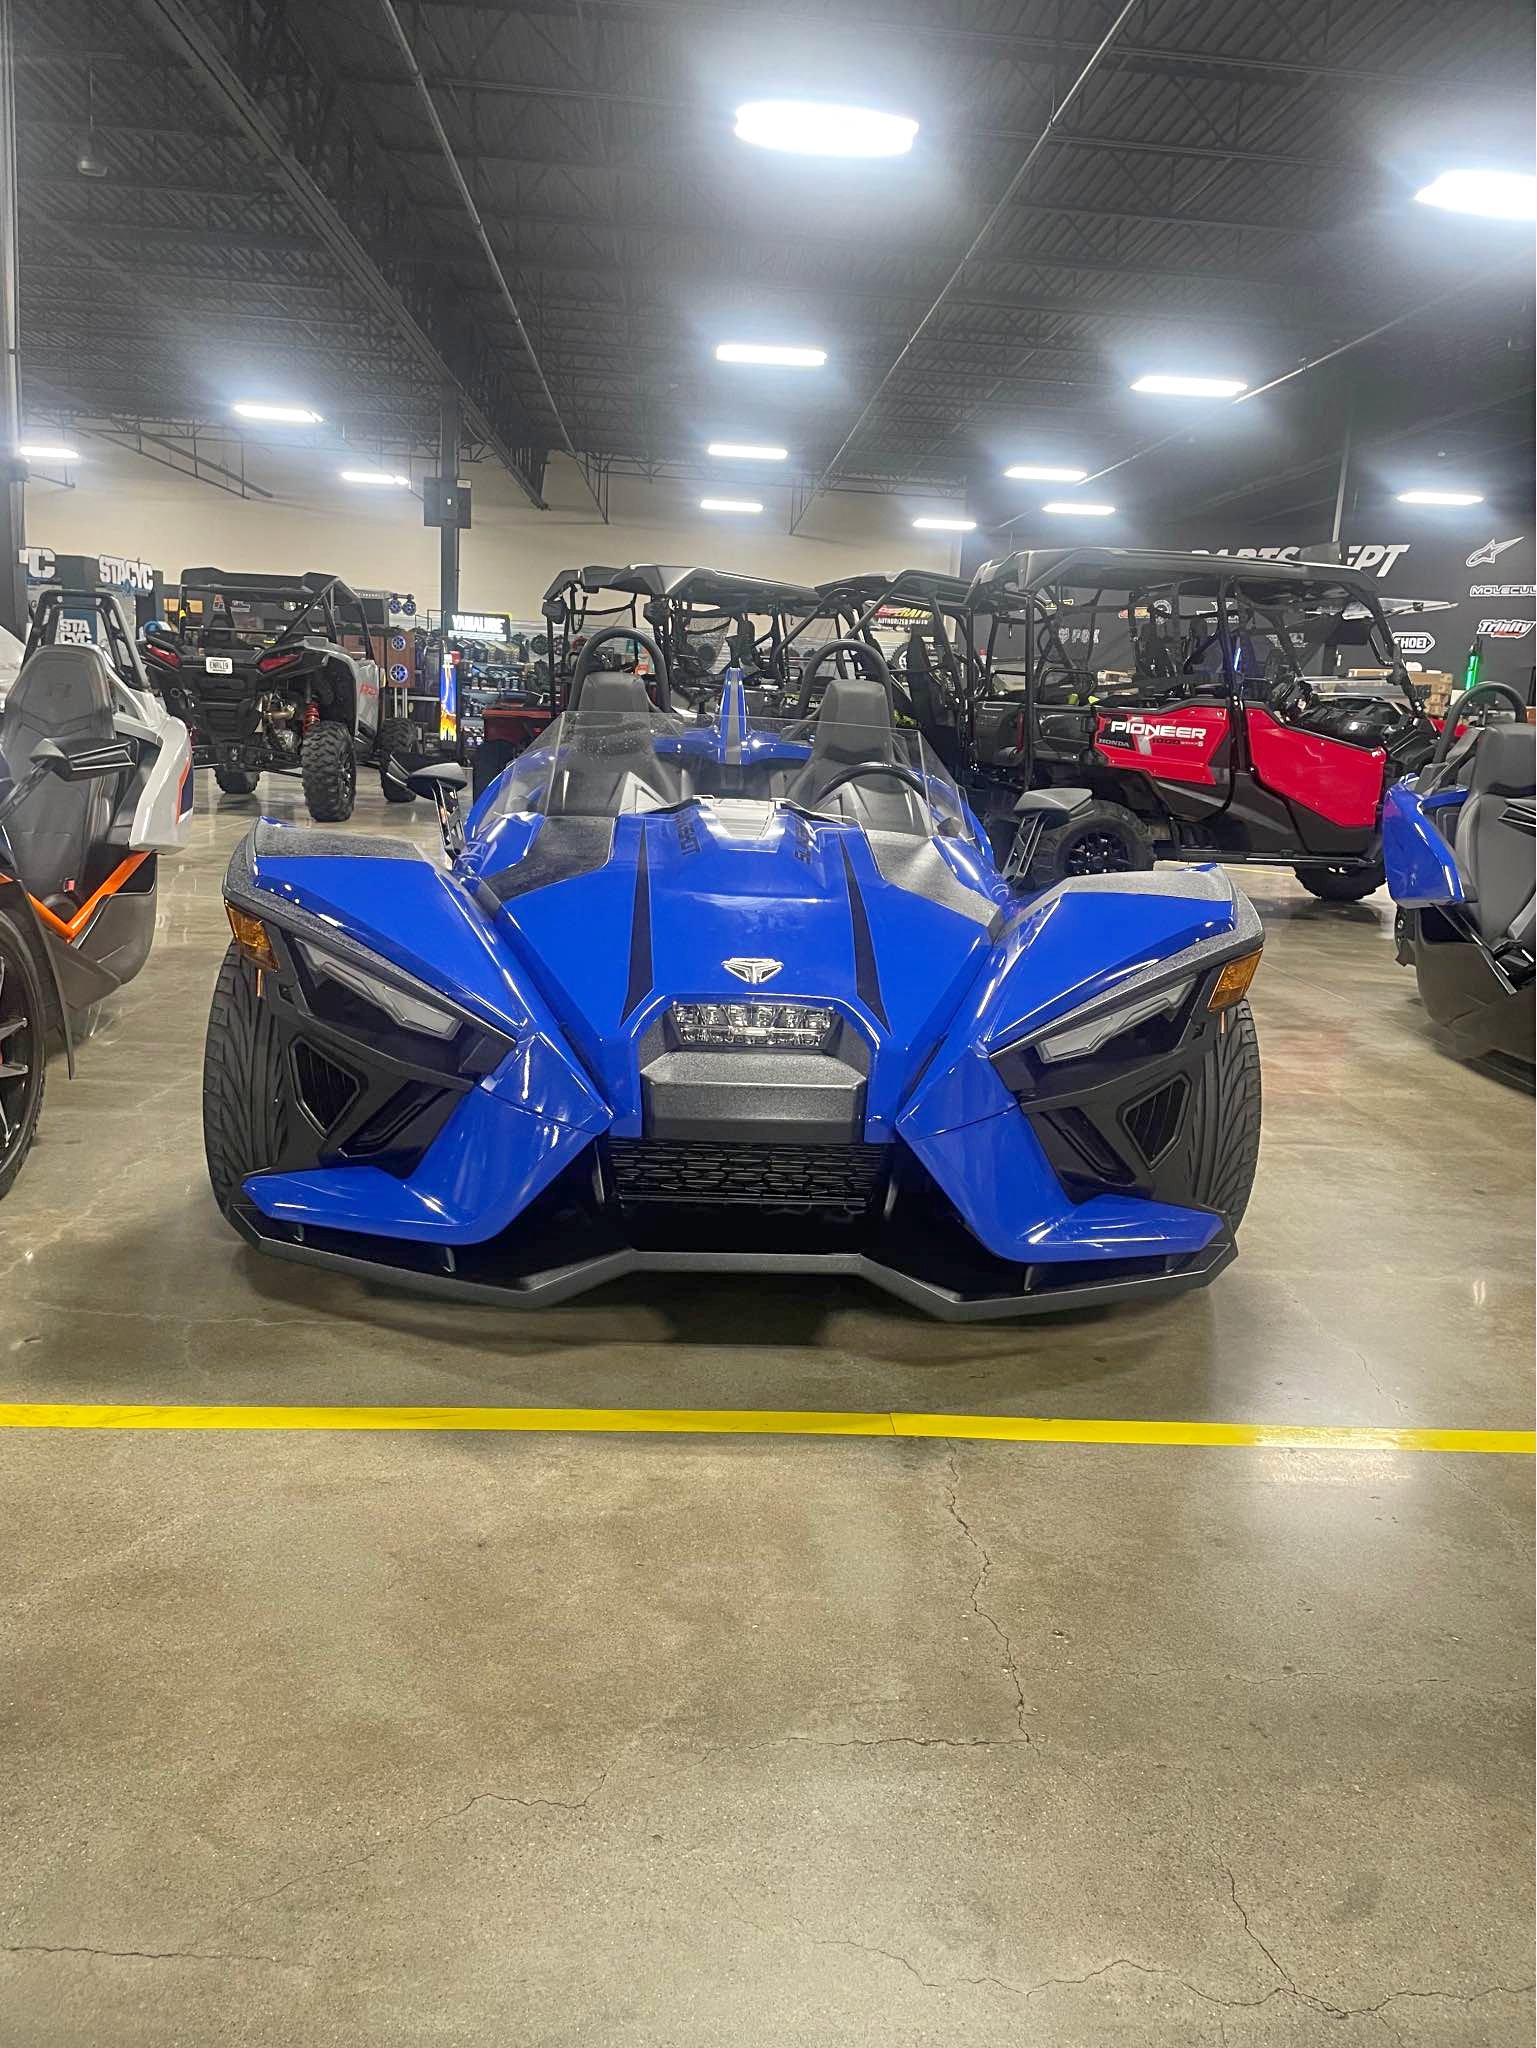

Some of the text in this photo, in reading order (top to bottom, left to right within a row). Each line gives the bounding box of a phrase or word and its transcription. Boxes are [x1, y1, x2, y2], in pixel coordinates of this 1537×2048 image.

[1347, 545, 1411, 578] PT
[99, 556, 154, 591] STACYC
[60, 620, 89, 634] STA
[1110, 720, 1207, 740] PIONEER
[1099, 738, 1130, 748] HONDA
